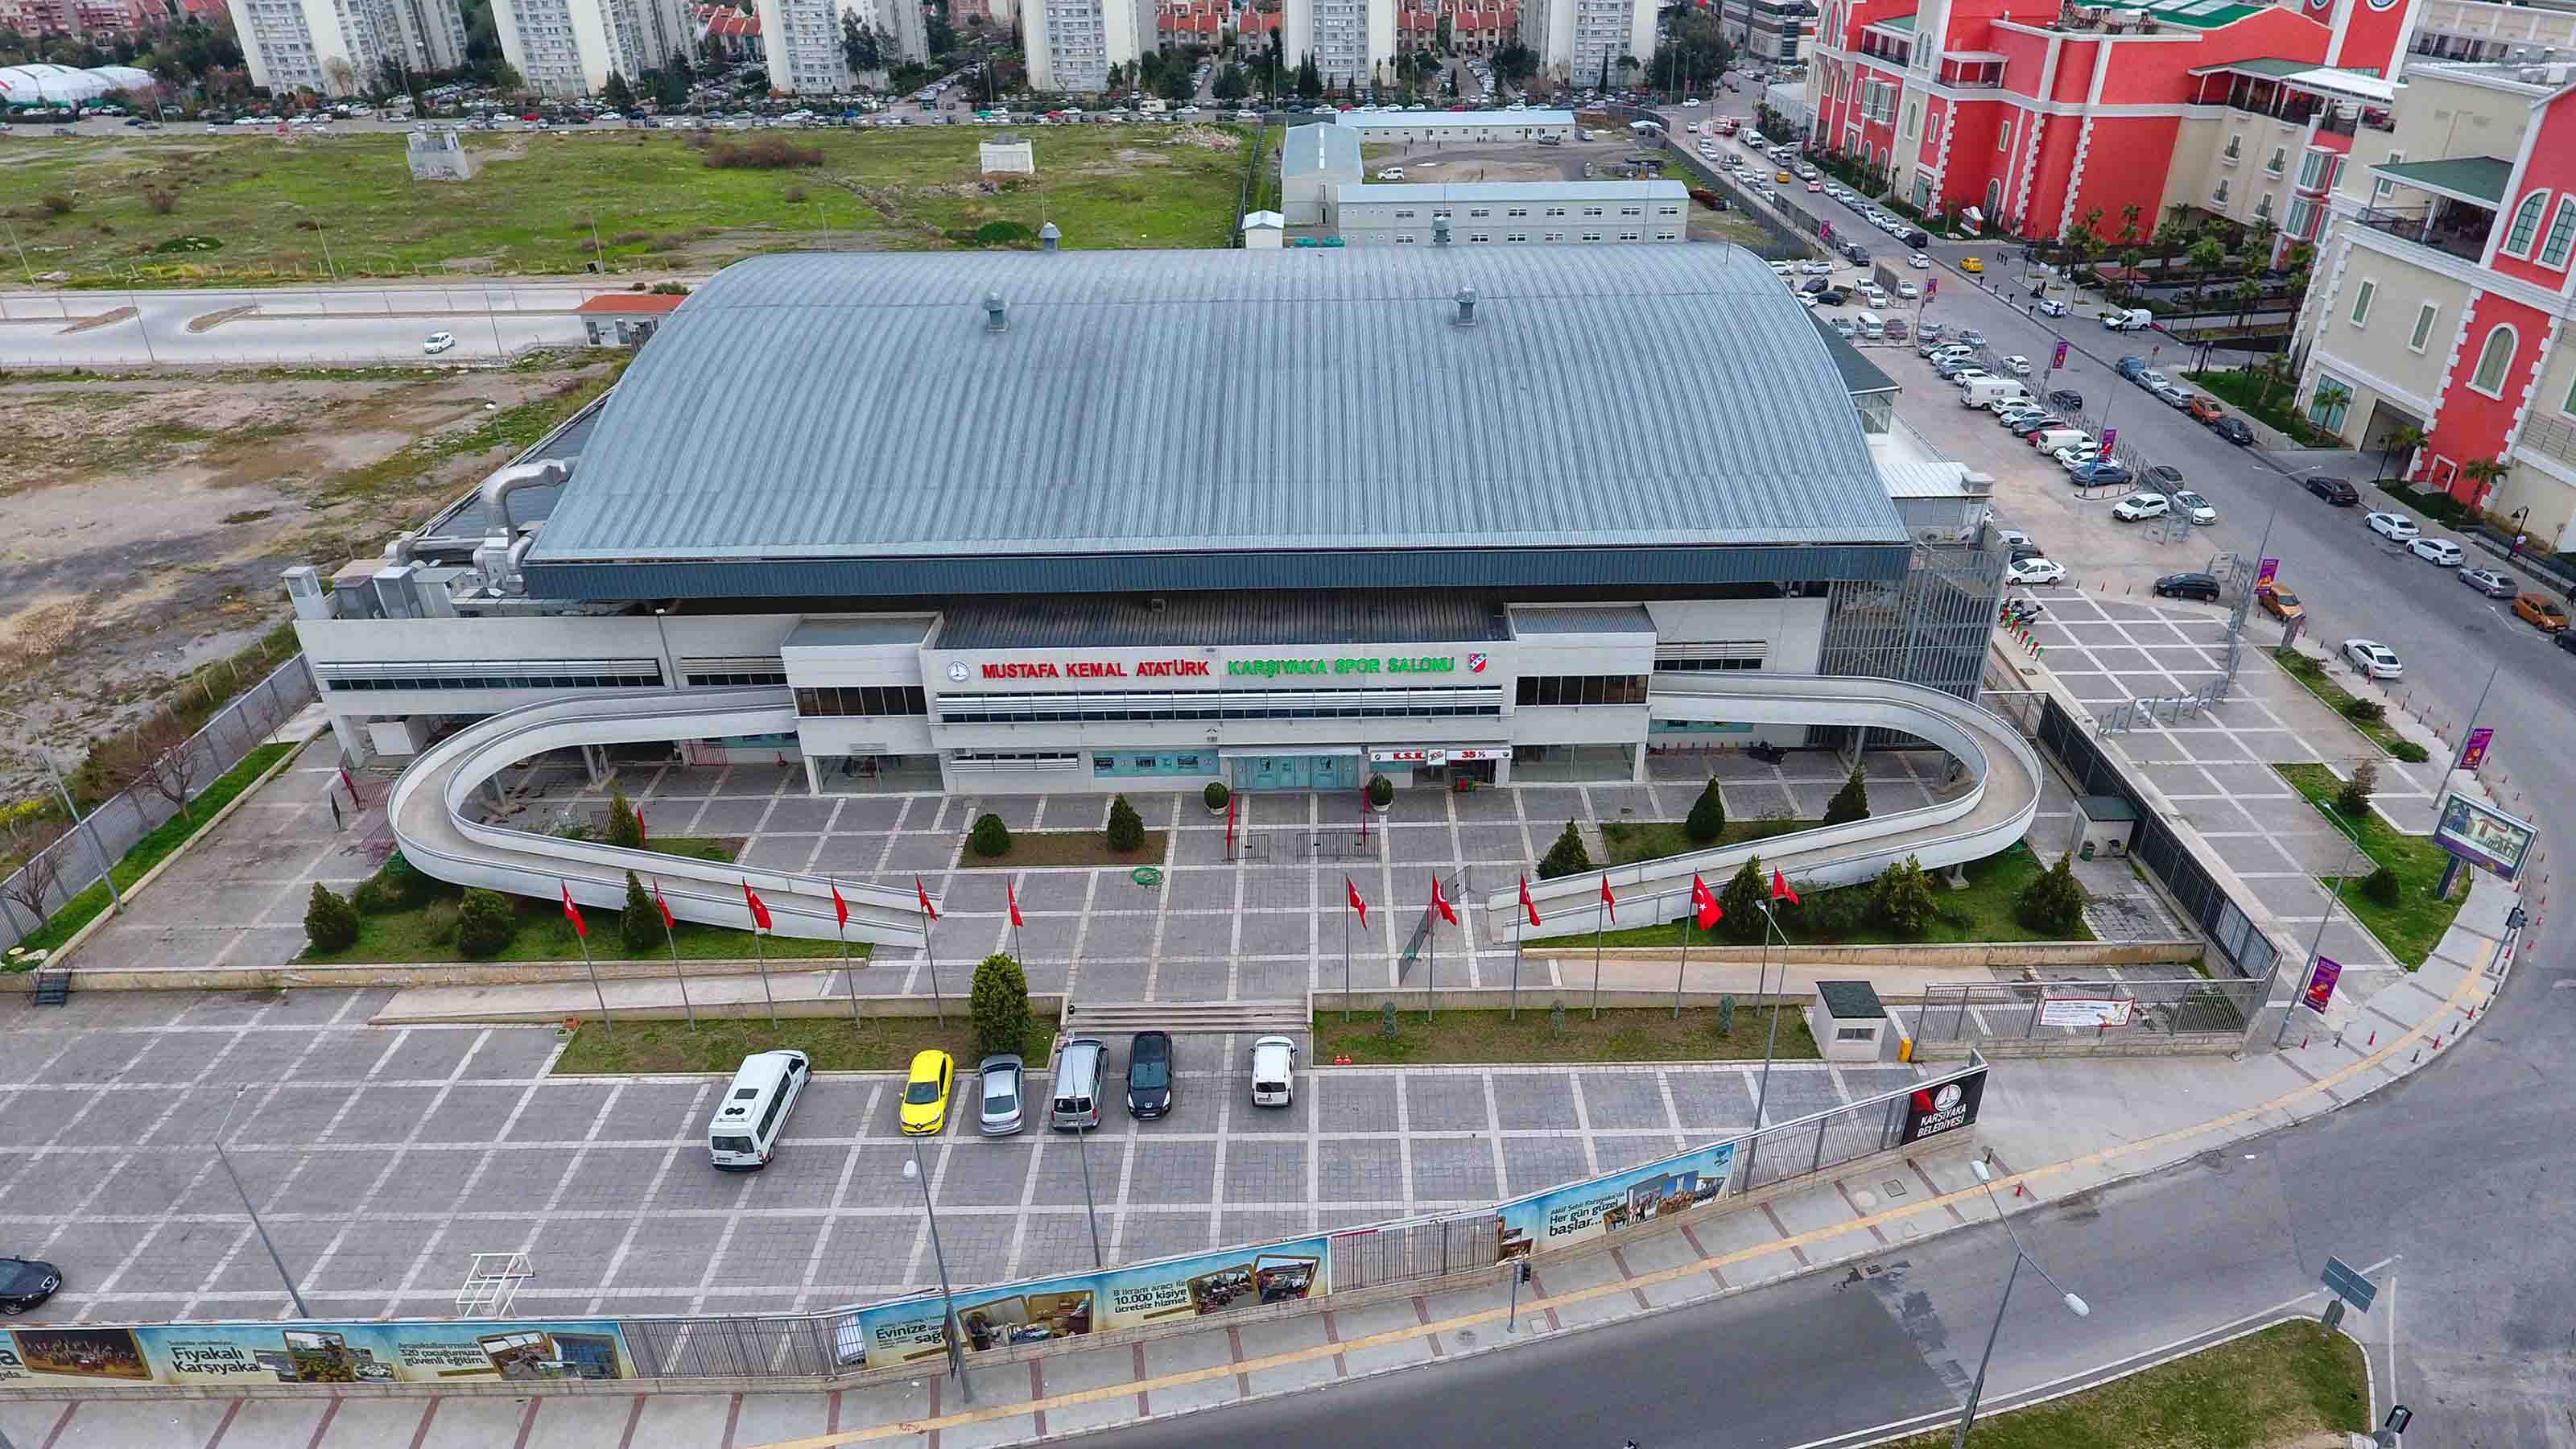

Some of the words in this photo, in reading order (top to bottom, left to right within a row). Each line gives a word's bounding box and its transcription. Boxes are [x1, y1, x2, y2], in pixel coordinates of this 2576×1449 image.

[982, 663, 1059, 679] MUSTAFA
[1066, 662, 1127, 678] KEMAL
[1136, 658, 1211, 677] ATATÜRK
[1334, 658, 1381, 675] SPOR
[1388, 656, 1455, 674] SALONU
[1550, 1215, 1568, 1224] Her
[1571, 1208, 1589, 1222] gün
[1592, 1199, 1618, 1216] güzel
[1114, 1293, 1153, 1305] 10.000
[1156, 1289, 1187, 1299] kişiye
[1115, 1302, 1153, 1314] ücretsiz
[1154, 1297, 1187, 1308] hizmet
[875, 1324, 927, 1340] Evinize
[171, 1346, 245, 1364] Fiyakalı
[404, 1356, 444, 1367] güvenli
[172, 1360, 262, 1375] Karşıyaka
